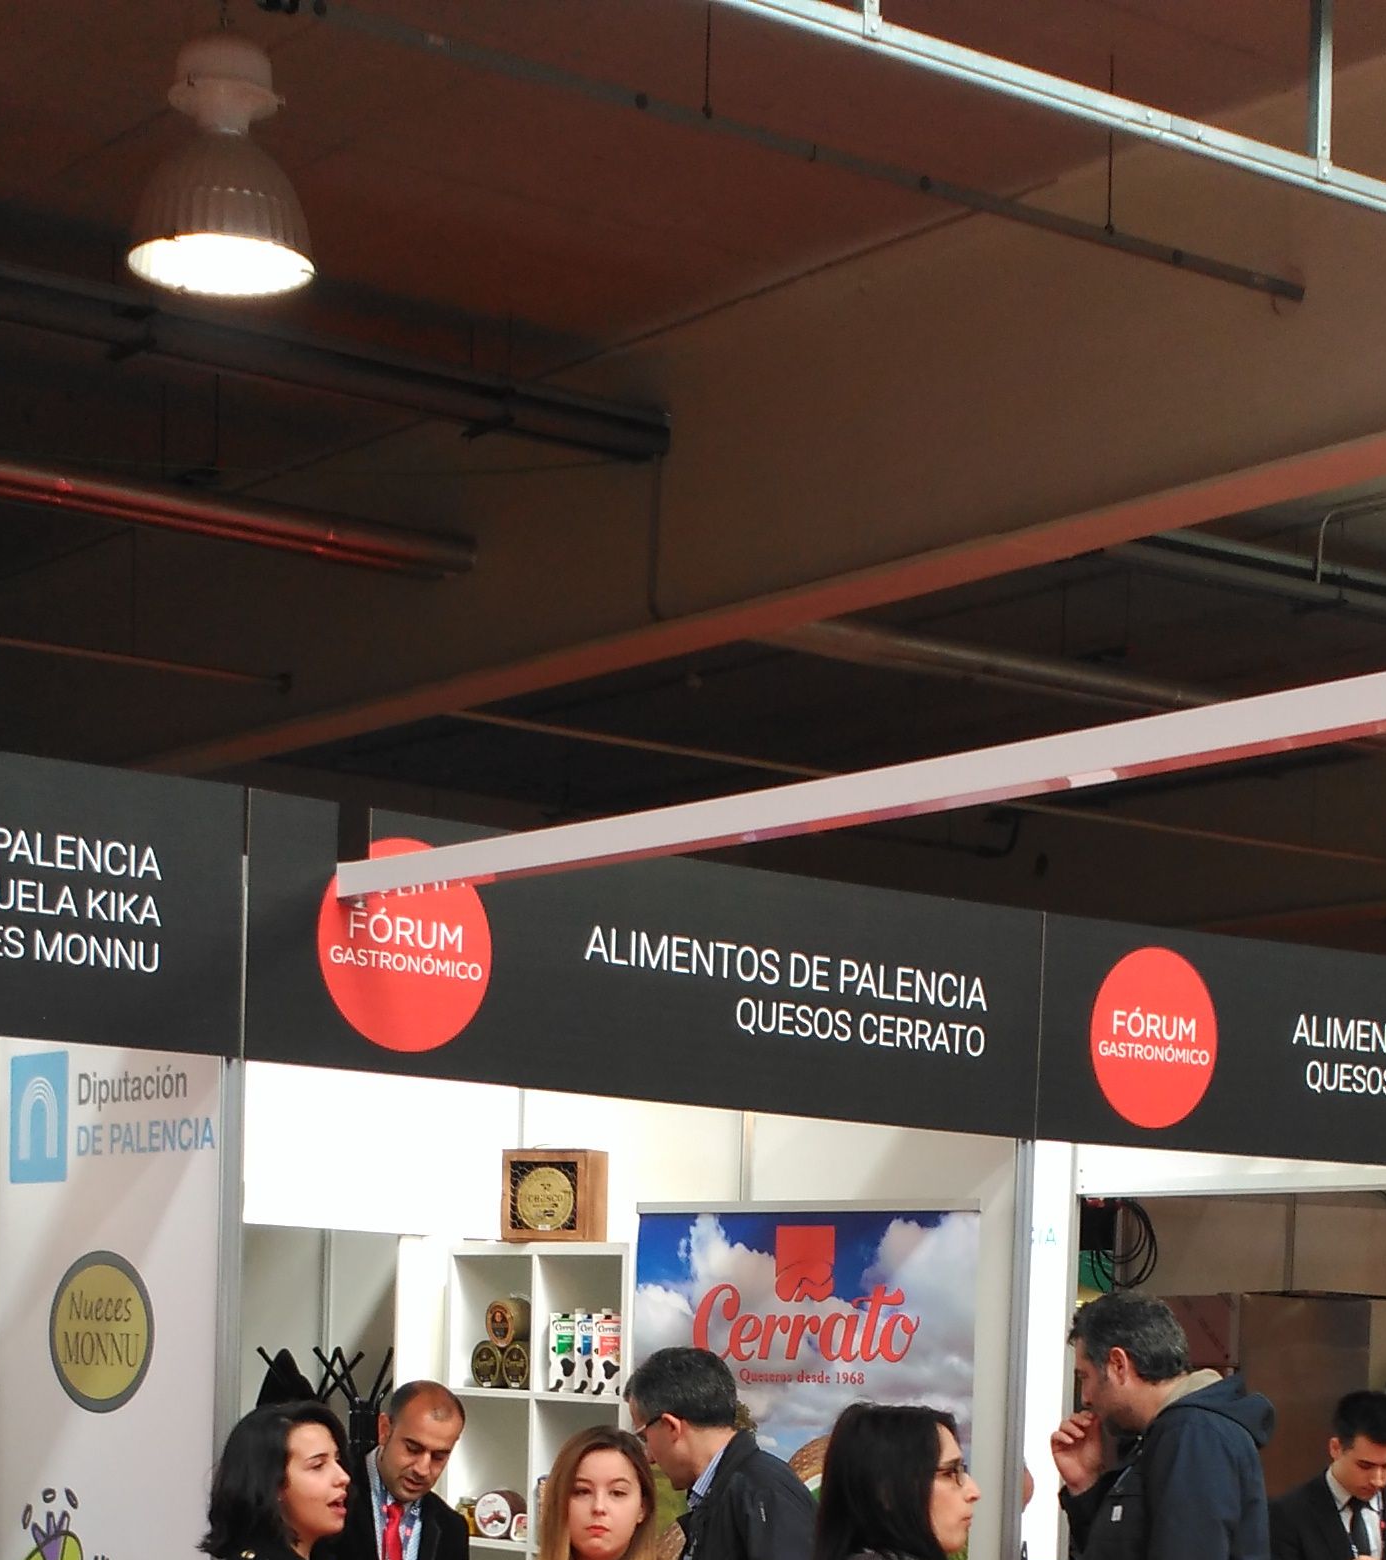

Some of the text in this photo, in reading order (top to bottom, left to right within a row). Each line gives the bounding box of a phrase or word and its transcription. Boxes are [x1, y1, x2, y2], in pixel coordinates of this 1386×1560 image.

[86, 889, 162, 928] KIKA
[349, 906, 463, 954] FÓRUM
[34, 929, 160, 973] MONNU
[329, 945, 482, 982] GASTRONÓMICO
[584, 925, 989, 1012] ALIMENTOS DE PALENCIA
[735, 997, 986, 1058] QUESOS CERRATO
[1113, 1006, 1197, 1043] FÓRUM
[1098, 1039, 1210, 1067] GASTRONÓMICO
[77, 1065, 188, 1112] Diputación
[77, 1117, 215, 1156] DE PALENCIA
[68, 1290, 133, 1323] Nueces
[693, 1283, 921, 1364] Cerrato
[62, 1331, 140, 1369] MONNU
[797, 1370, 830, 1384] desde
[836, 1371, 865, 1385] 1968
